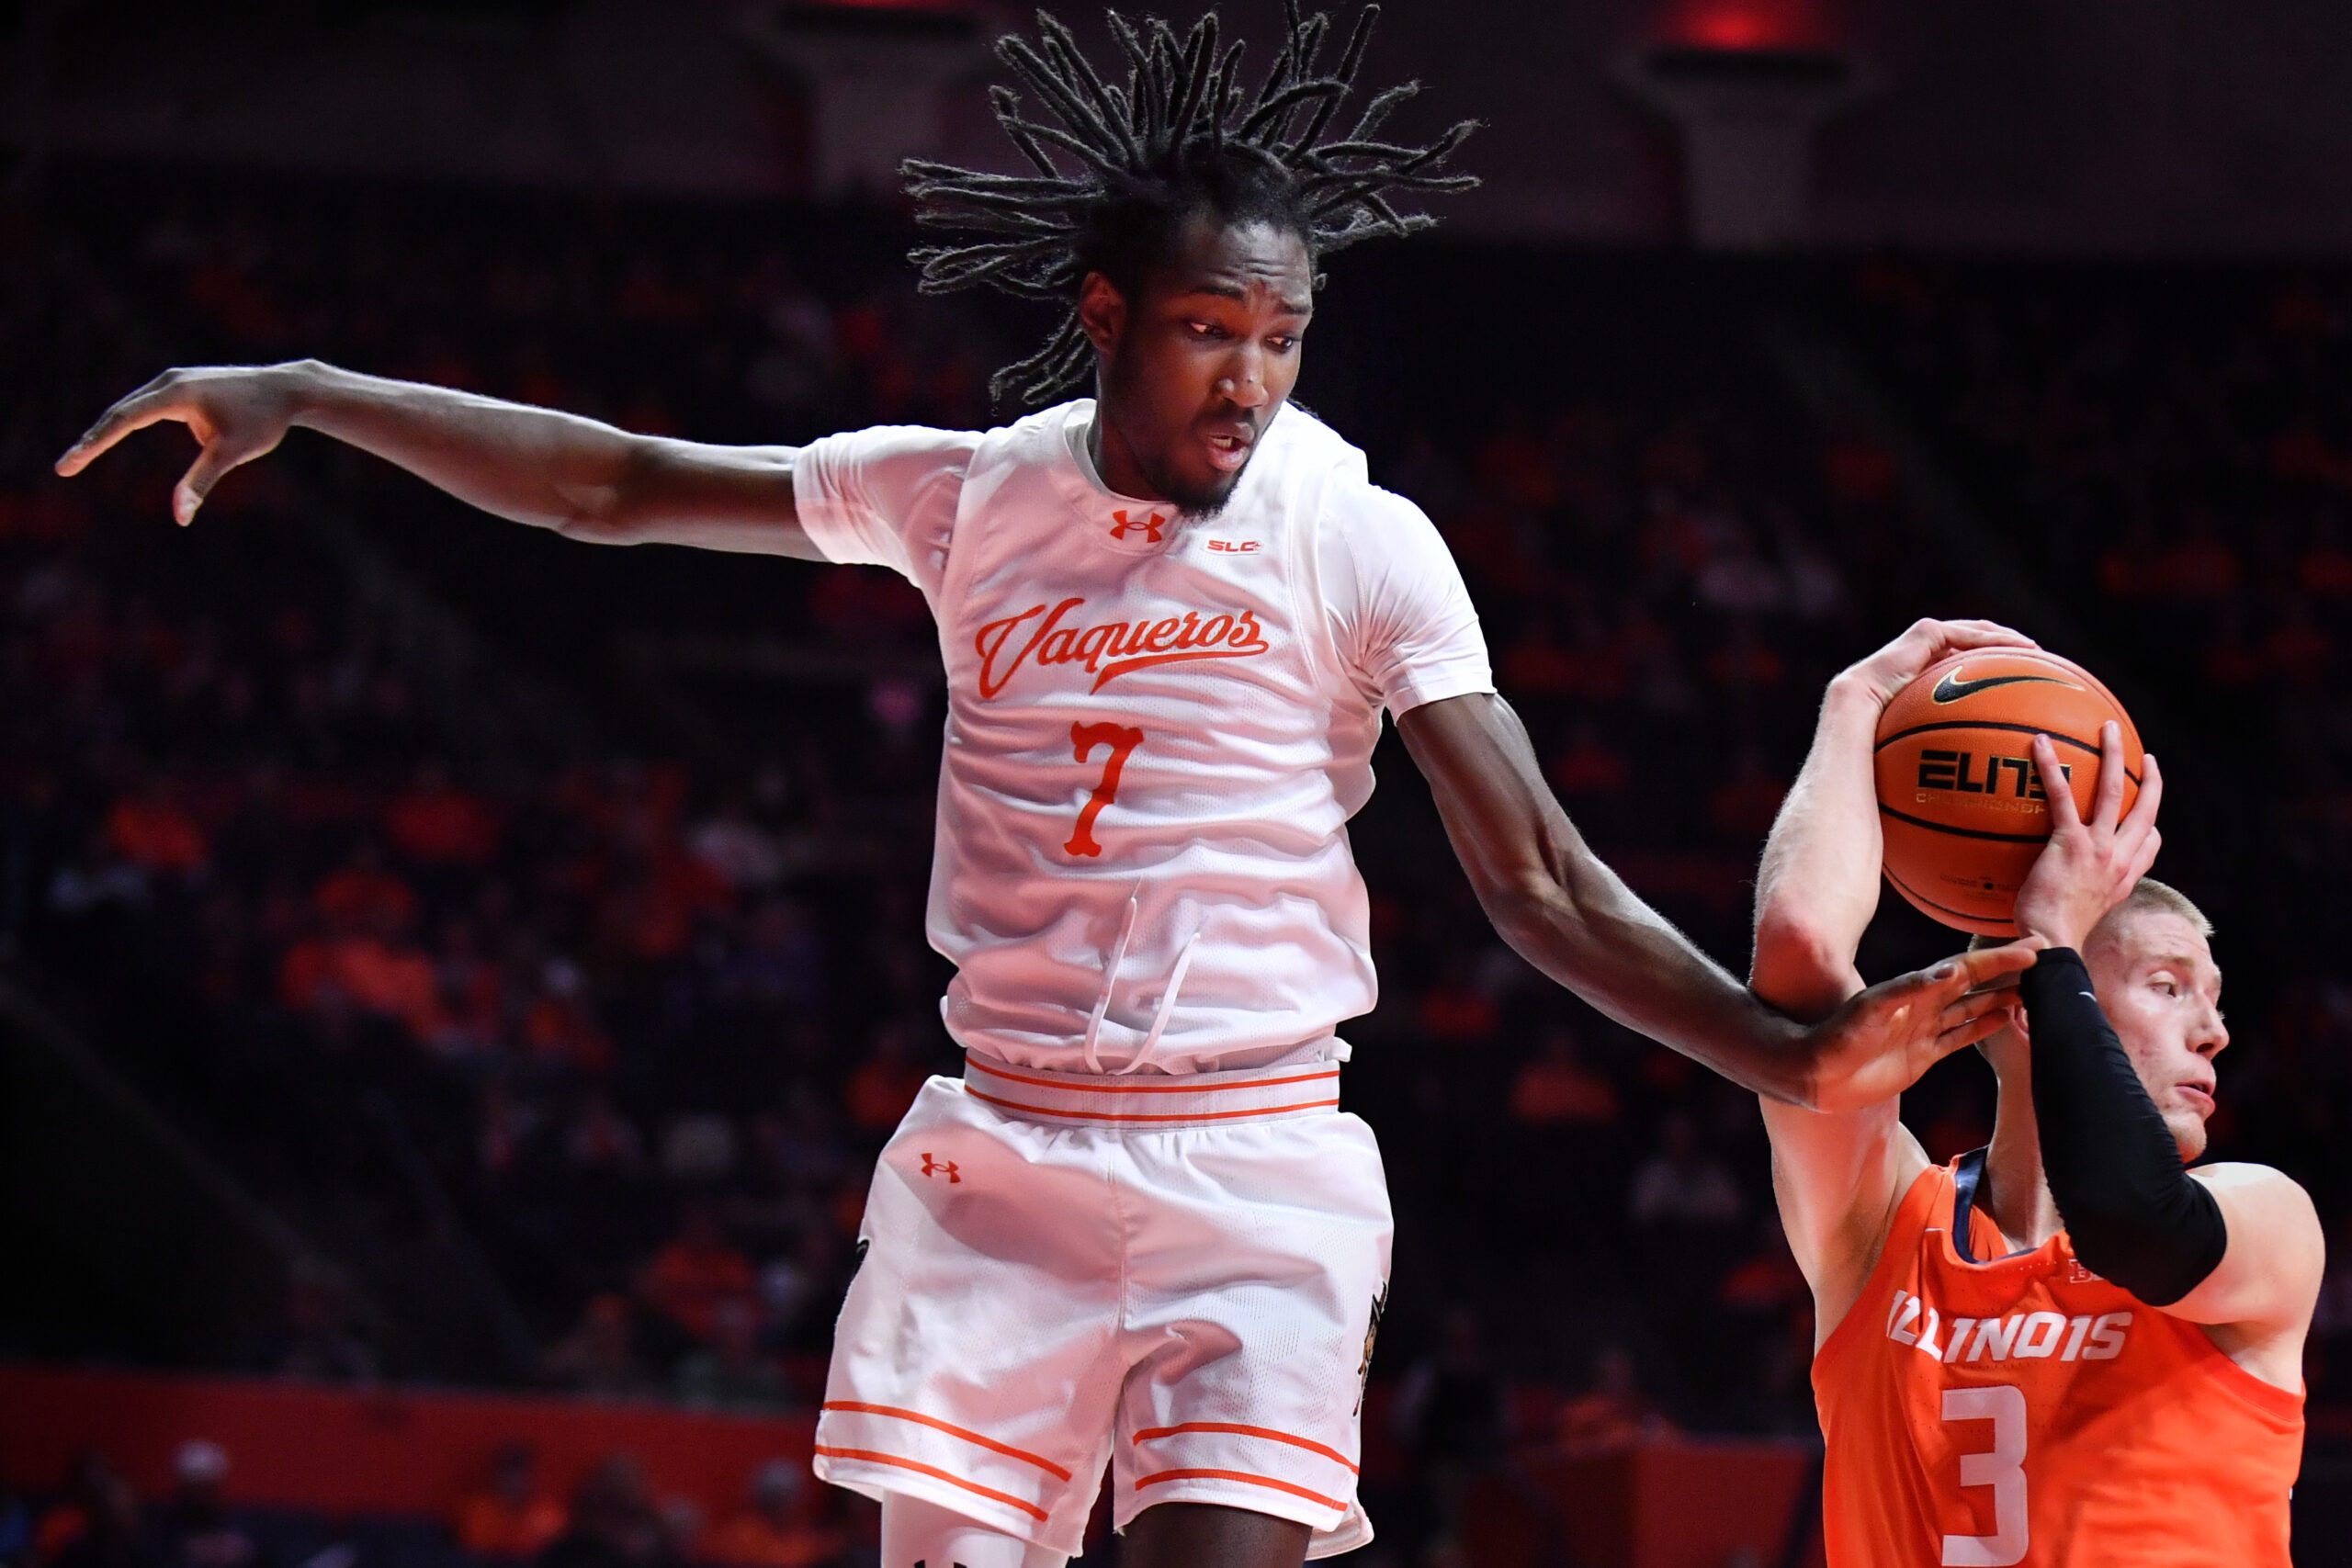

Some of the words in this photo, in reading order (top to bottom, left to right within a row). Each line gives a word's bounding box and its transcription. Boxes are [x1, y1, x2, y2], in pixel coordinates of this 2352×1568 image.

[1207, 539, 1261, 552] SLC
[975, 597, 1269, 699] Vaqueros
[1063, 720, 1145, 858] 7
[1886, 1289, 2133, 1364] ILLINOIS
[1941, 1384, 2030, 1568] 3
